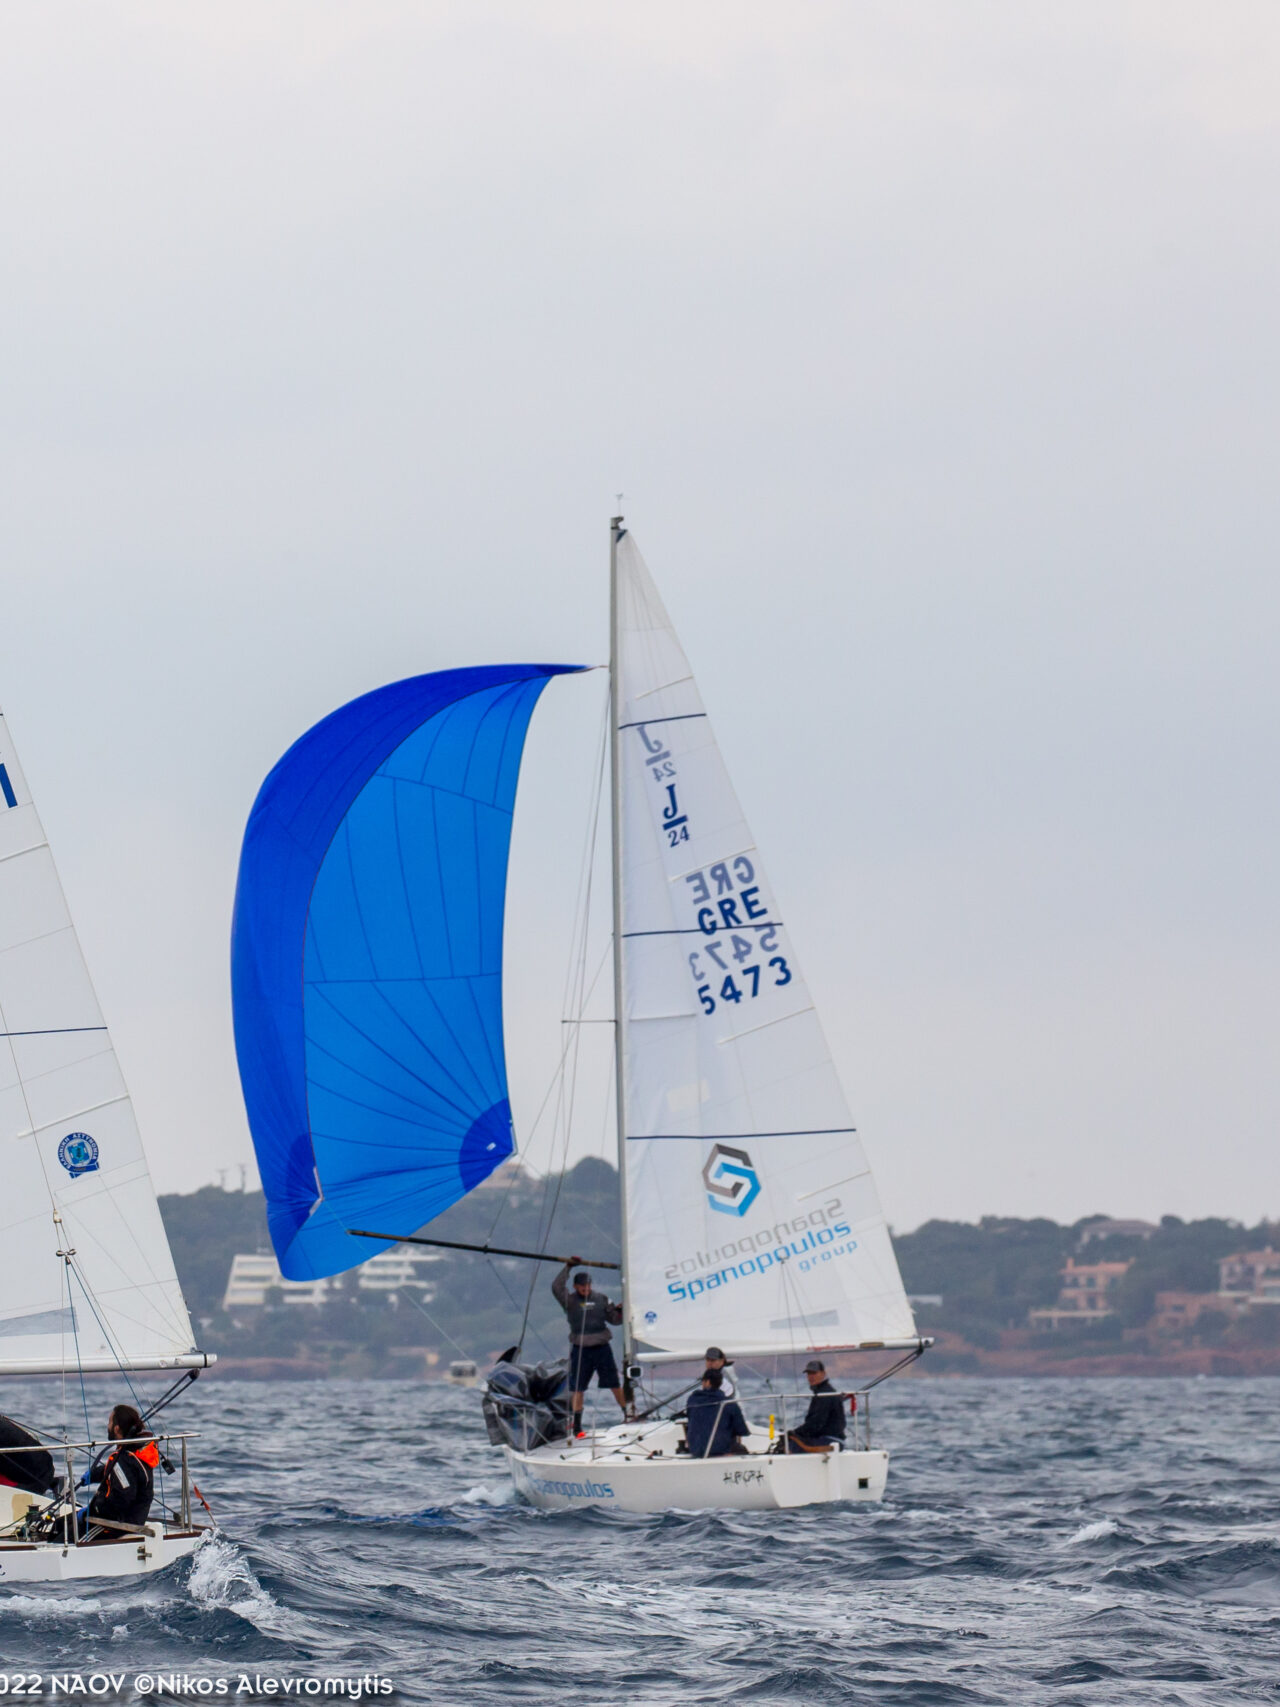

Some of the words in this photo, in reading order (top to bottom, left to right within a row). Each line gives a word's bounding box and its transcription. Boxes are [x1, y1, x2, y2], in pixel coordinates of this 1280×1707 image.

[663, 783, 678, 819] J
[668, 825, 690, 848] 24
[697, 886, 768, 936] GRE
[697, 956, 792, 1015] 5473
[667, 1221, 851, 1302] Spanopoulos
[798, 1240, 858, 1273] group
